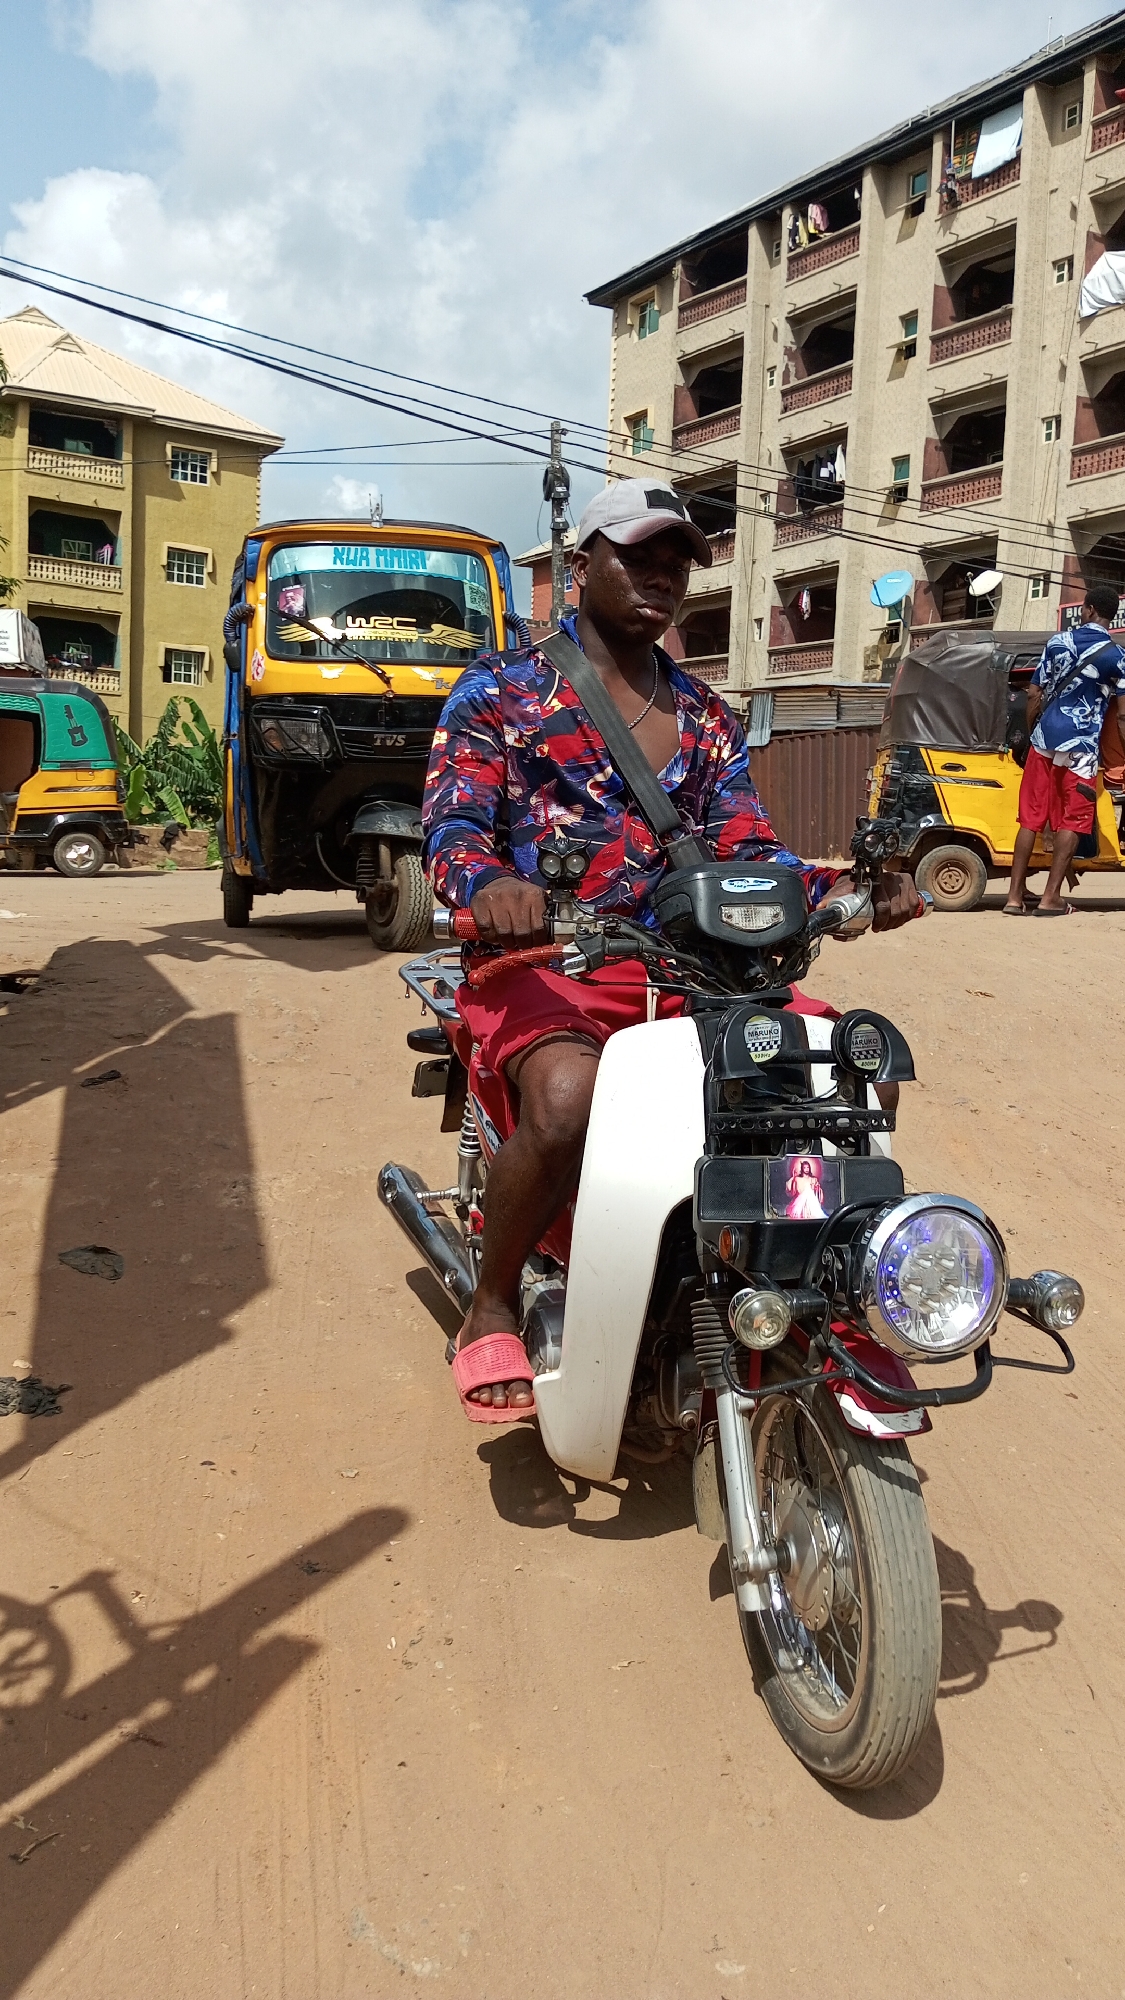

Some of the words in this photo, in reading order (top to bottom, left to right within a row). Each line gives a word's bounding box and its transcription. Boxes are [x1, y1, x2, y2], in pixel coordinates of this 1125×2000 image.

[346, 615, 417, 631] WRC
[373, 733, 407, 747] TVS
[747, 1028, 780, 1038] MARUKO
